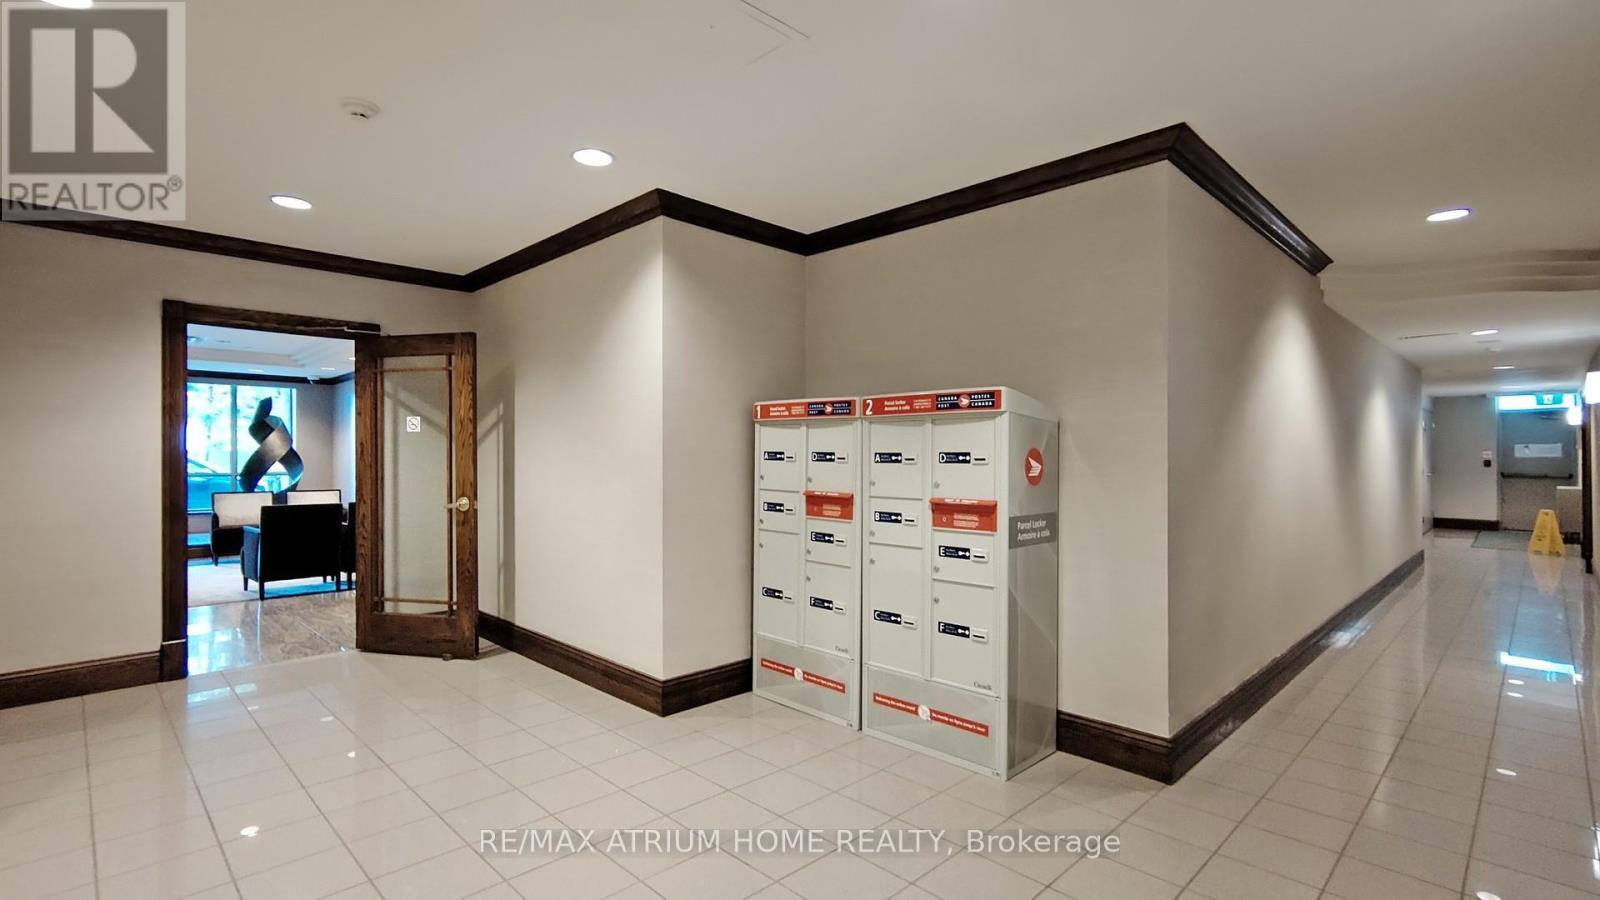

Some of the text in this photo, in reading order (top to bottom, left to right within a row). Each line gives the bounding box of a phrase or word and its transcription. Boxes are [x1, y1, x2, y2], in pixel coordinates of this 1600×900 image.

[865, 399, 873, 415] 2
[756, 405, 761, 419] 1
[875, 453, 880, 463] A
[940, 453, 946, 462] D
[875, 512, 880, 521] B
[940, 547, 945, 556] E
[875, 611, 880, 620] C
[940, 623, 945, 632] F
